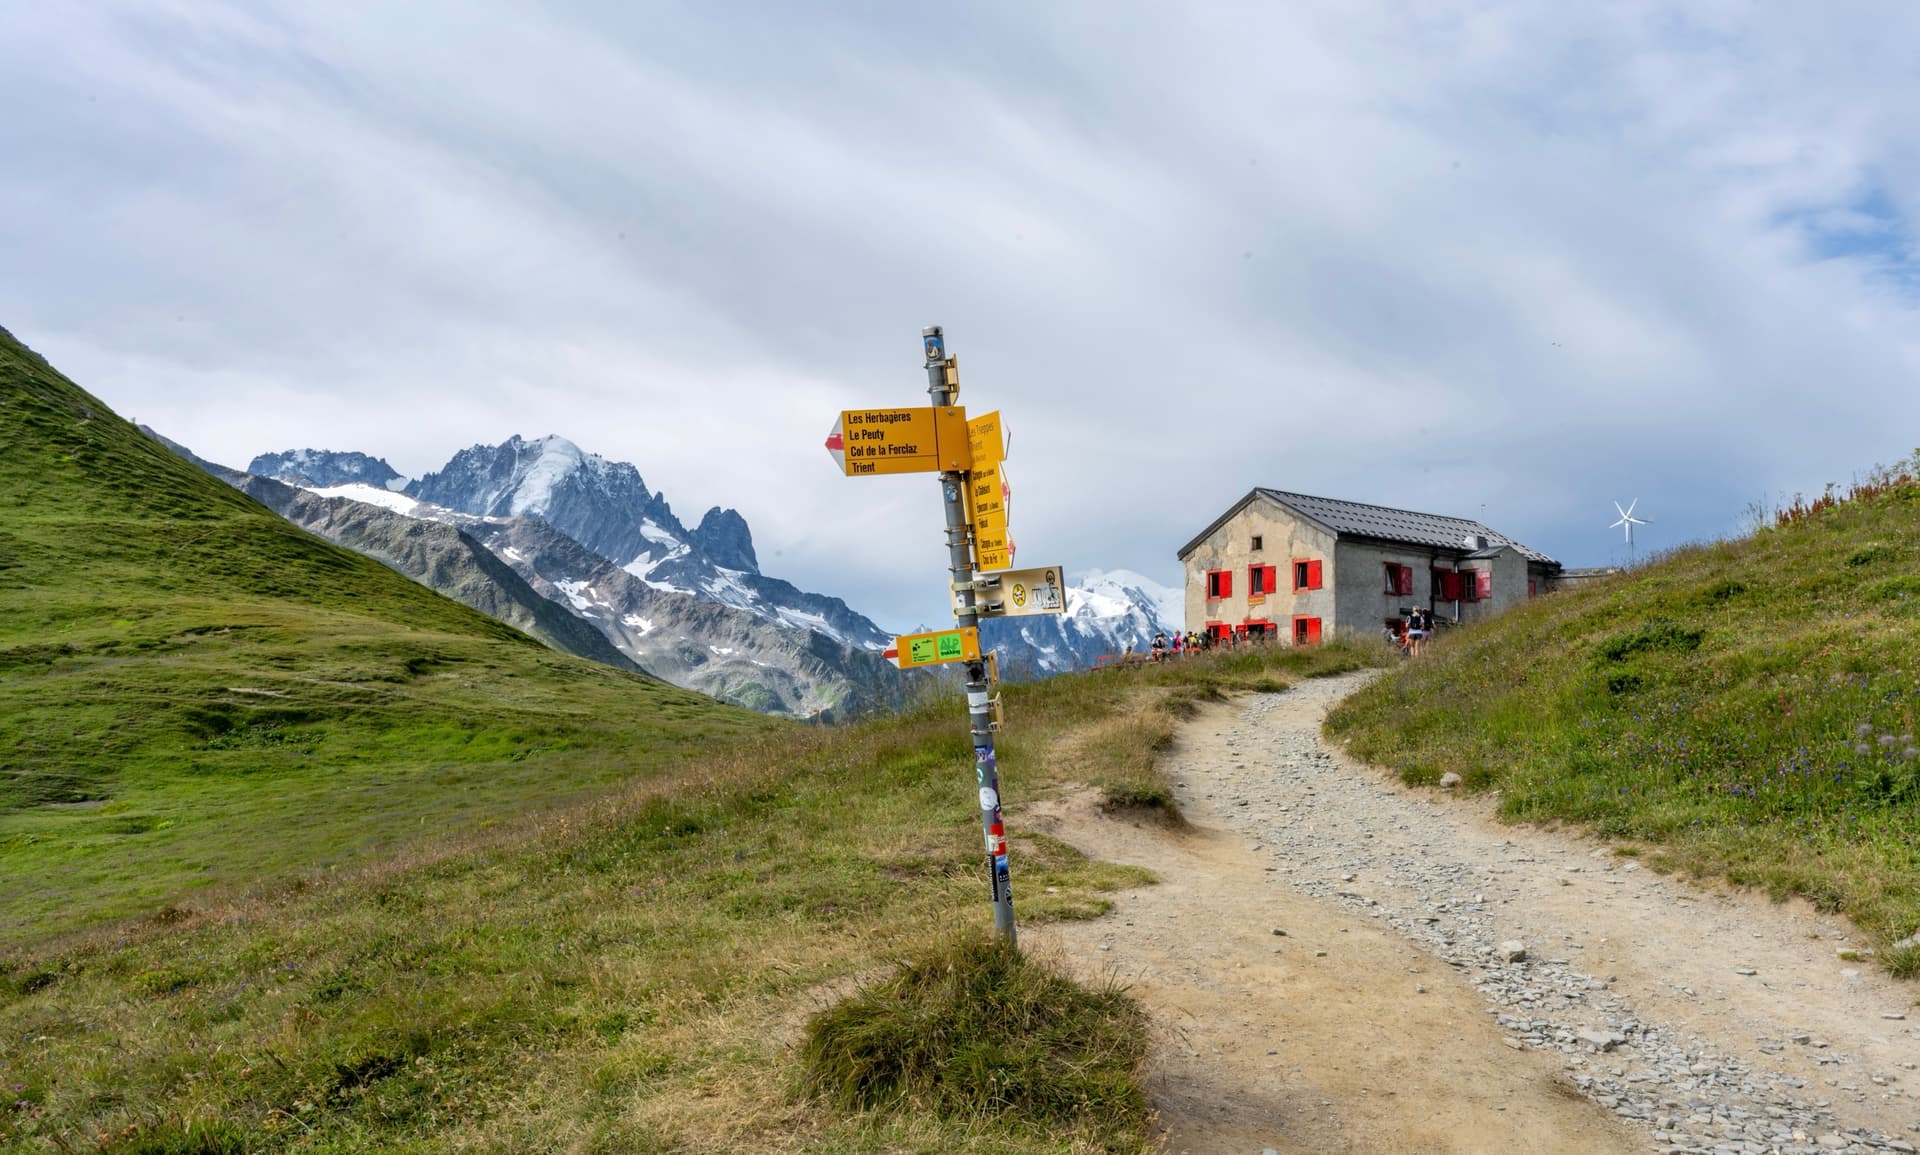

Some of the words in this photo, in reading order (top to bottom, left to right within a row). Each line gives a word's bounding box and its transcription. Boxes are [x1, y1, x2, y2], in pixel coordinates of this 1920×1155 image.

[848, 413, 863, 425] Les
[865, 411, 912, 425] Herbagères
[849, 429, 860, 441] Le
[862, 428, 885, 441] Peuty
[850, 445, 864, 457] Col
[866, 444, 876, 456] de
[878, 443, 886, 455] la
[888, 443, 918, 455] Forclaz
[852, 461, 876, 473] Trient
